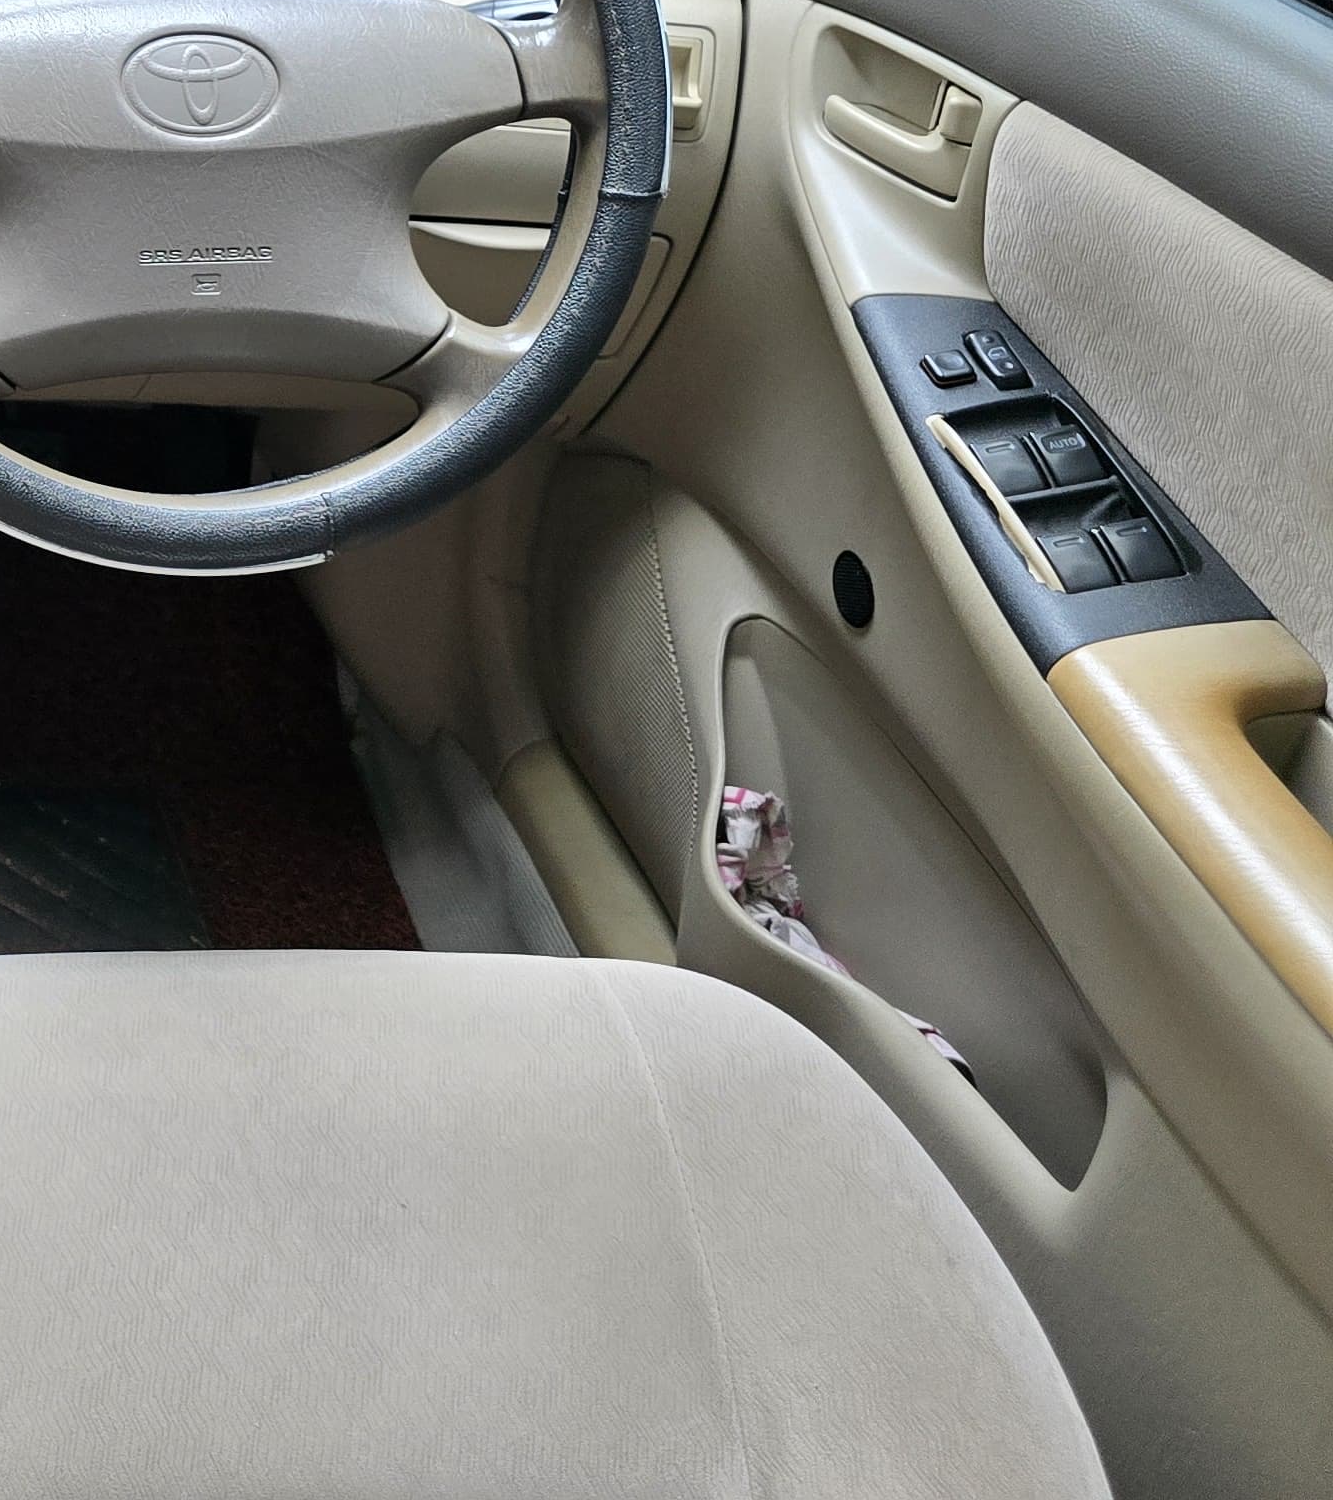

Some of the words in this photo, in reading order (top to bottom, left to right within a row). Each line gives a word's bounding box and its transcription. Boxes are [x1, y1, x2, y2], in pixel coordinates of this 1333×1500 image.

[139, 249, 183, 263] SRS
[187, 246, 274, 261] AIRBAG
[1049, 436, 1078, 450] AUTO
